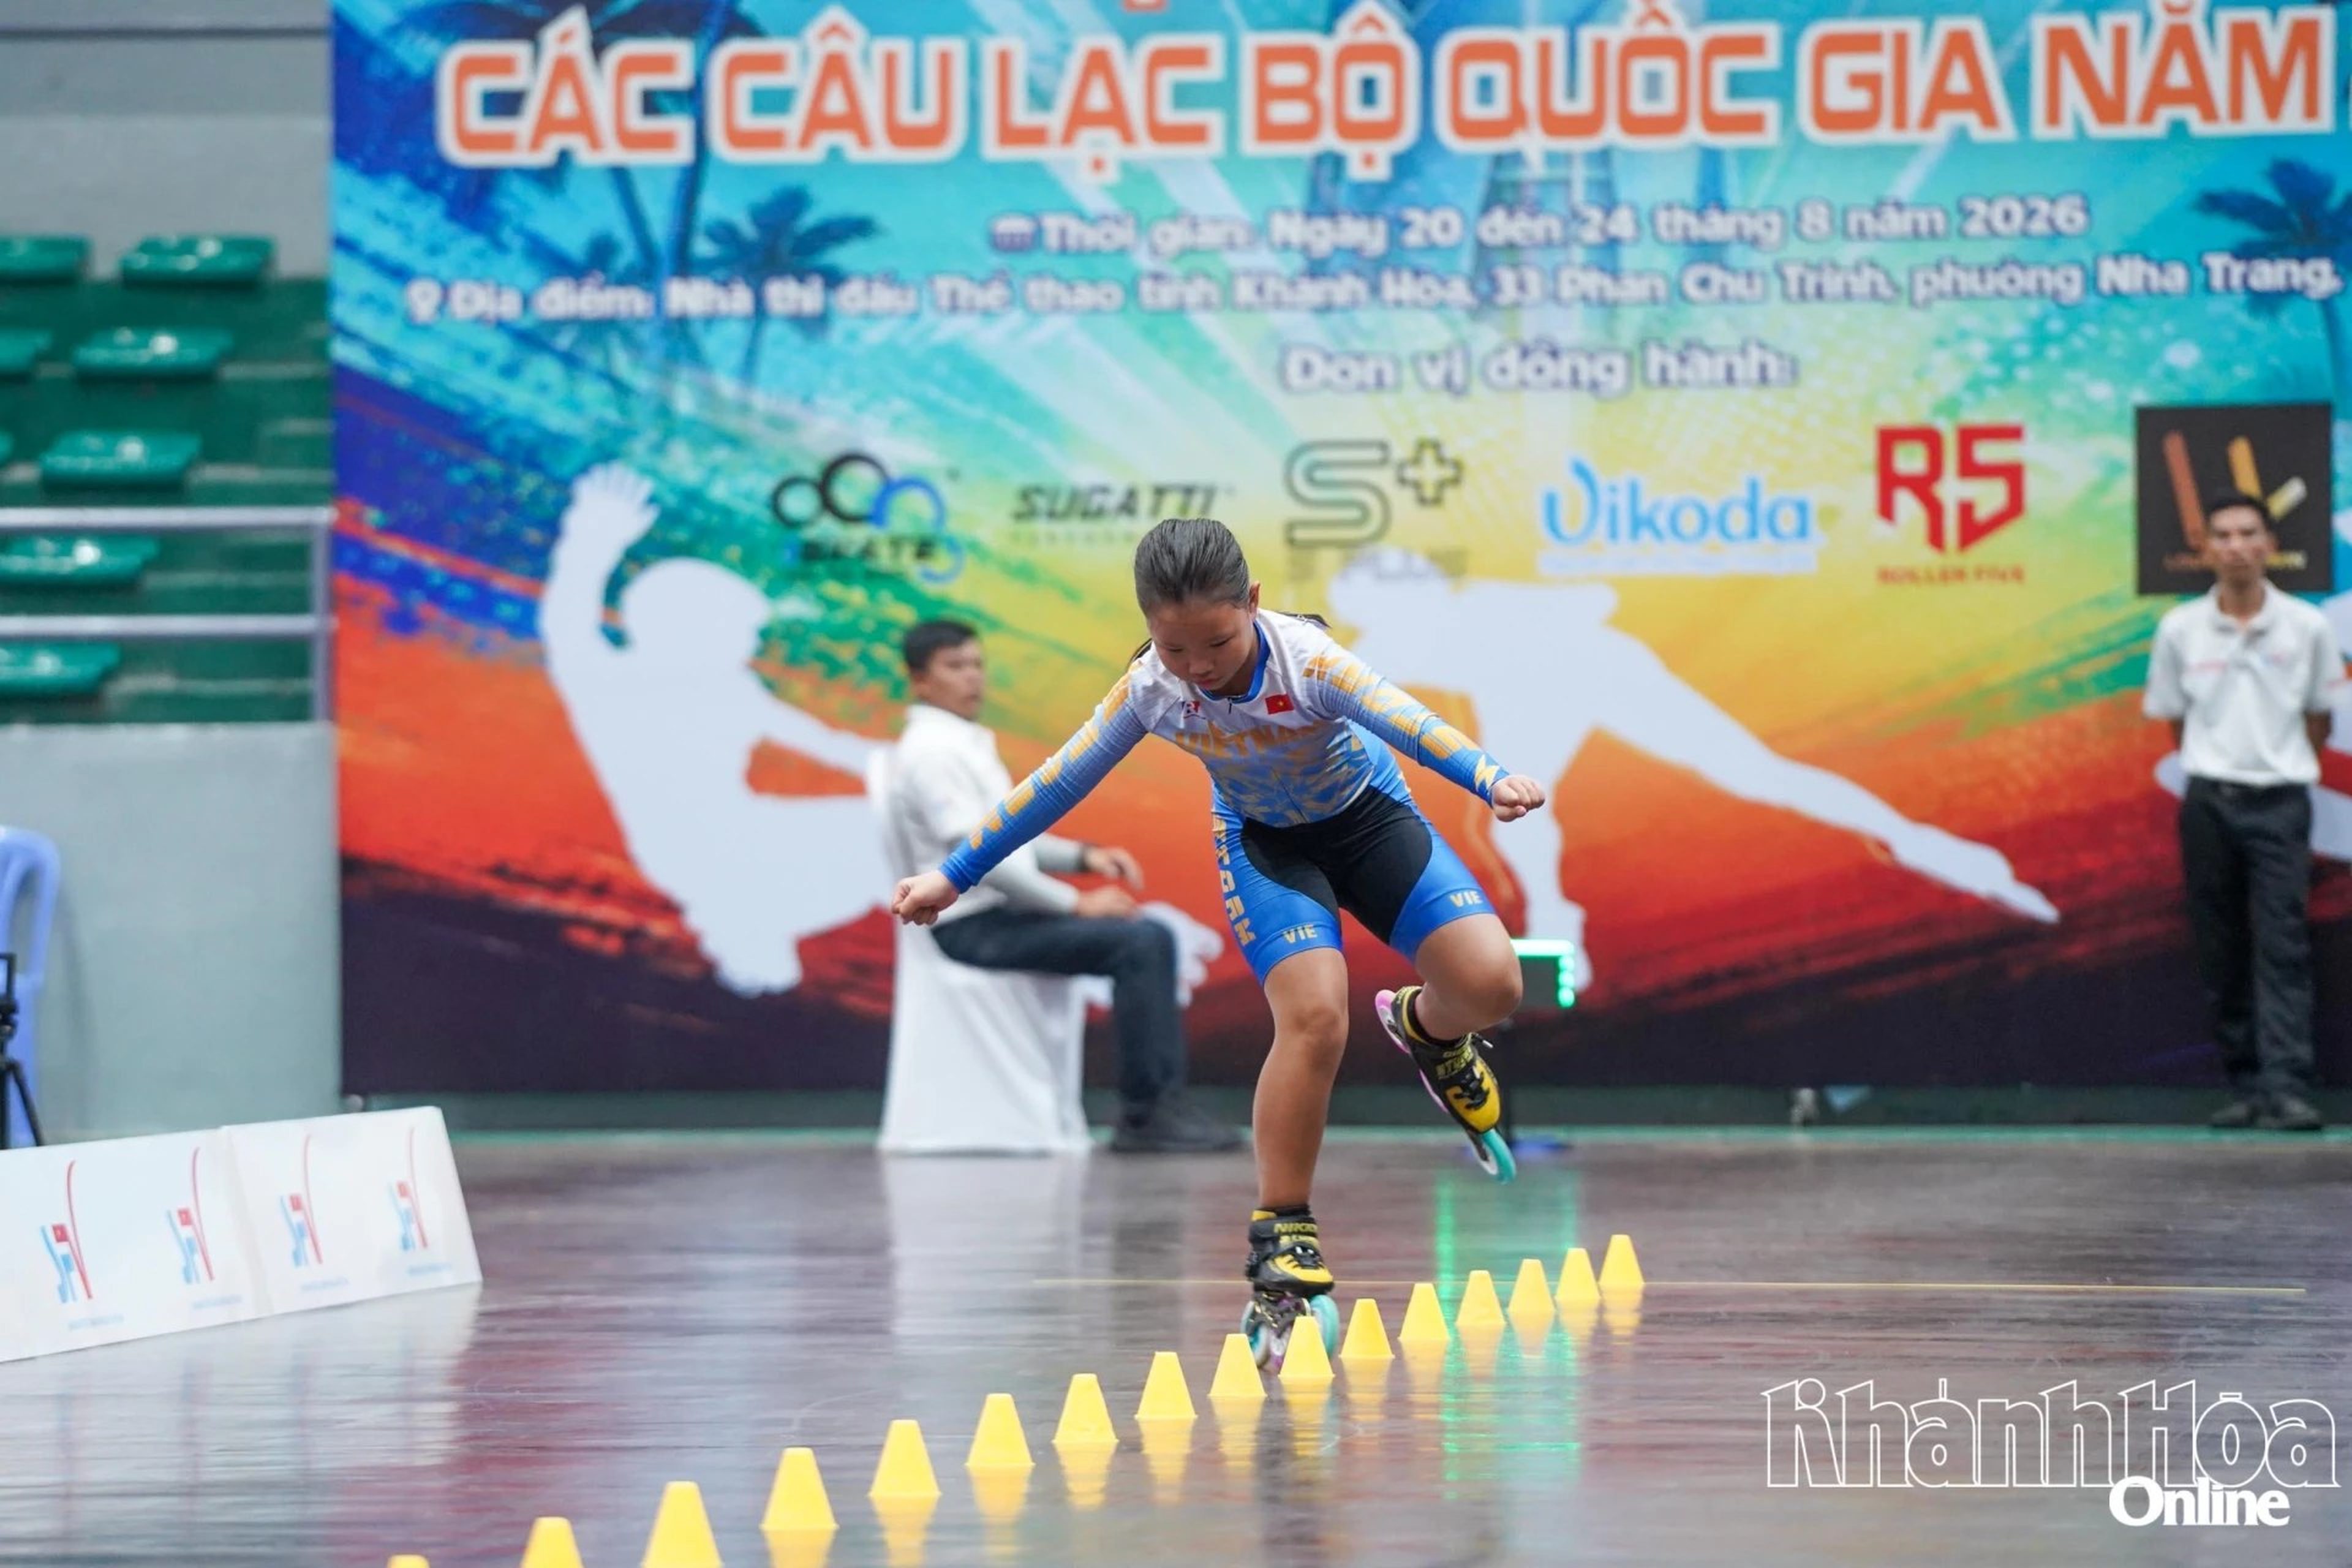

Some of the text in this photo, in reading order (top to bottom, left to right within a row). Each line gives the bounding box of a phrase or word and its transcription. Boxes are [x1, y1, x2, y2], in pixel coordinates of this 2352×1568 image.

[441, 0, 2334, 183] CÁC CÂU LẠC BỘ QUỐC GIA NĂM
[1402, 207, 1462, 246] 20
[1581, 204, 1637, 243] 24
[1798, 198, 1833, 241] 8
[1845, 199, 1945, 240] năm
[1960, 196, 2089, 237] 2026
[1025, 273, 1125, 313] thao
[1556, 263, 1668, 303] Phan
[2095, 252, 2190, 296] Nha
[1416, 344, 1469, 396] vị
[1013, 484, 1216, 521] SUGATTI
[1540, 456, 1812, 545] Vikoda
[1877, 426, 2024, 553] R5
[1449, 889, 1483, 908] VIE
[1283, 924, 1317, 944] VIE
